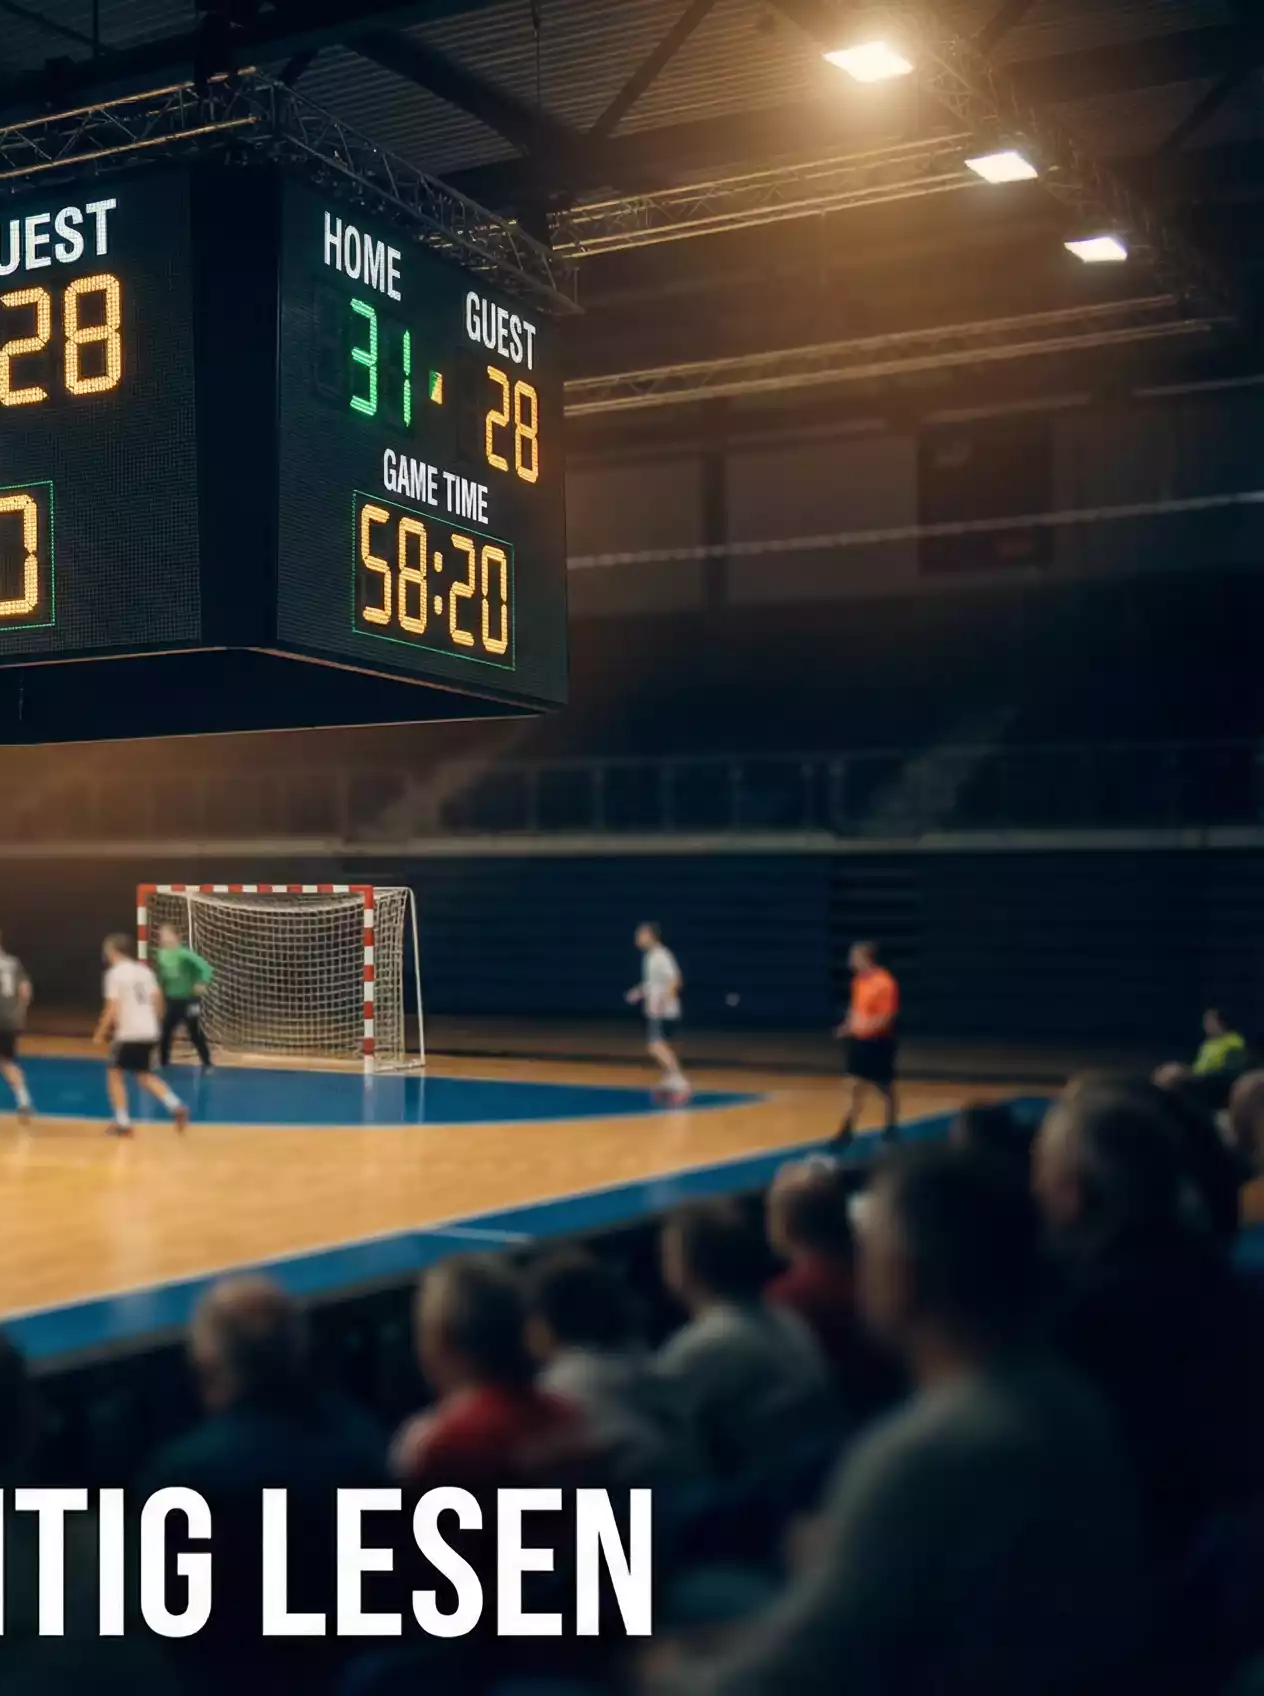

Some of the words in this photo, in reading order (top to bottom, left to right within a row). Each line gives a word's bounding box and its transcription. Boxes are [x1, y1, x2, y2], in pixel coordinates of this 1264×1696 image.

[324, 211, 402, 302] HOME
[466, 291, 536, 371] GUEST
[350, 298, 412, 427] 31
[485, 365, 539, 484] 28
[383, 448, 438, 506] GAME
[442, 470, 489, 525] TIME
[360, 503, 508, 656] 58:20
